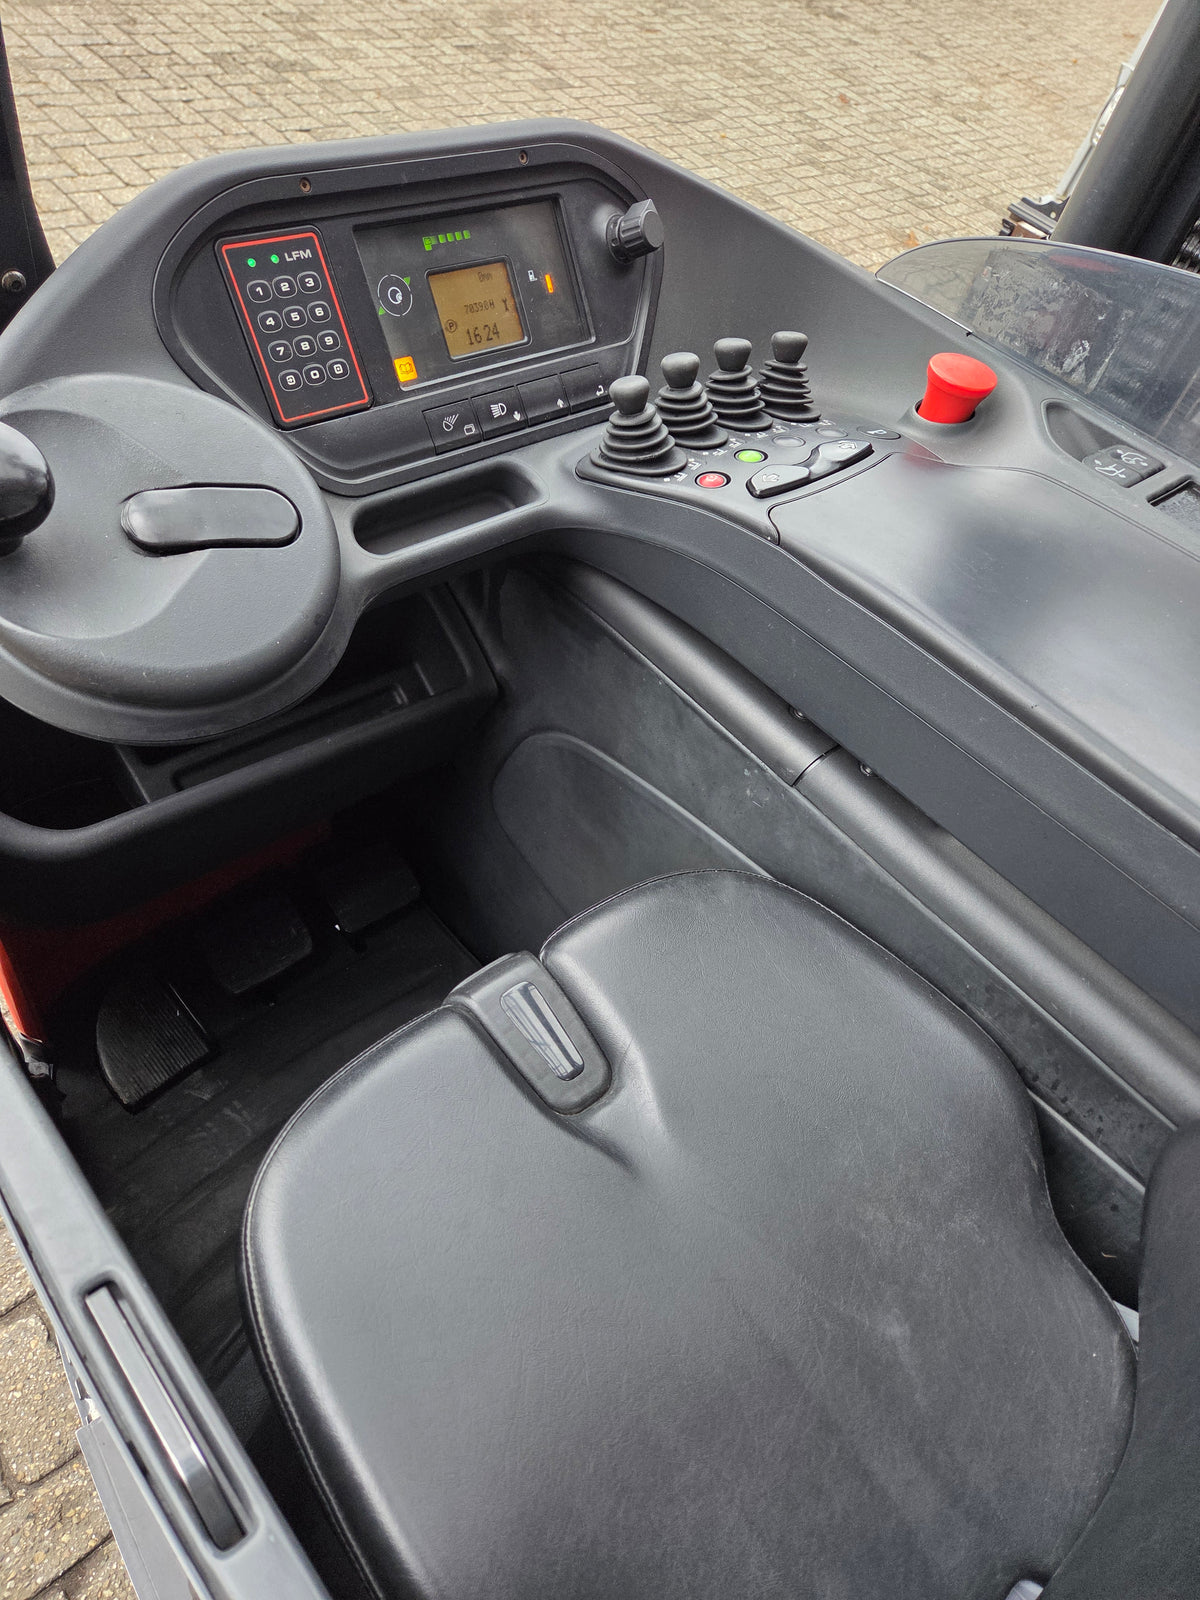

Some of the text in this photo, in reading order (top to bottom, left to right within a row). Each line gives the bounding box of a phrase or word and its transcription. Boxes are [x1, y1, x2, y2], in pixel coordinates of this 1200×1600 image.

[284, 249, 312, 262] LFM
[256, 278, 315, 296] 1 2 3
[266, 307, 324, 326] 4 5 6
[276, 336, 334, 356] 7 8 9
[310, 370, 320, 379] 0
